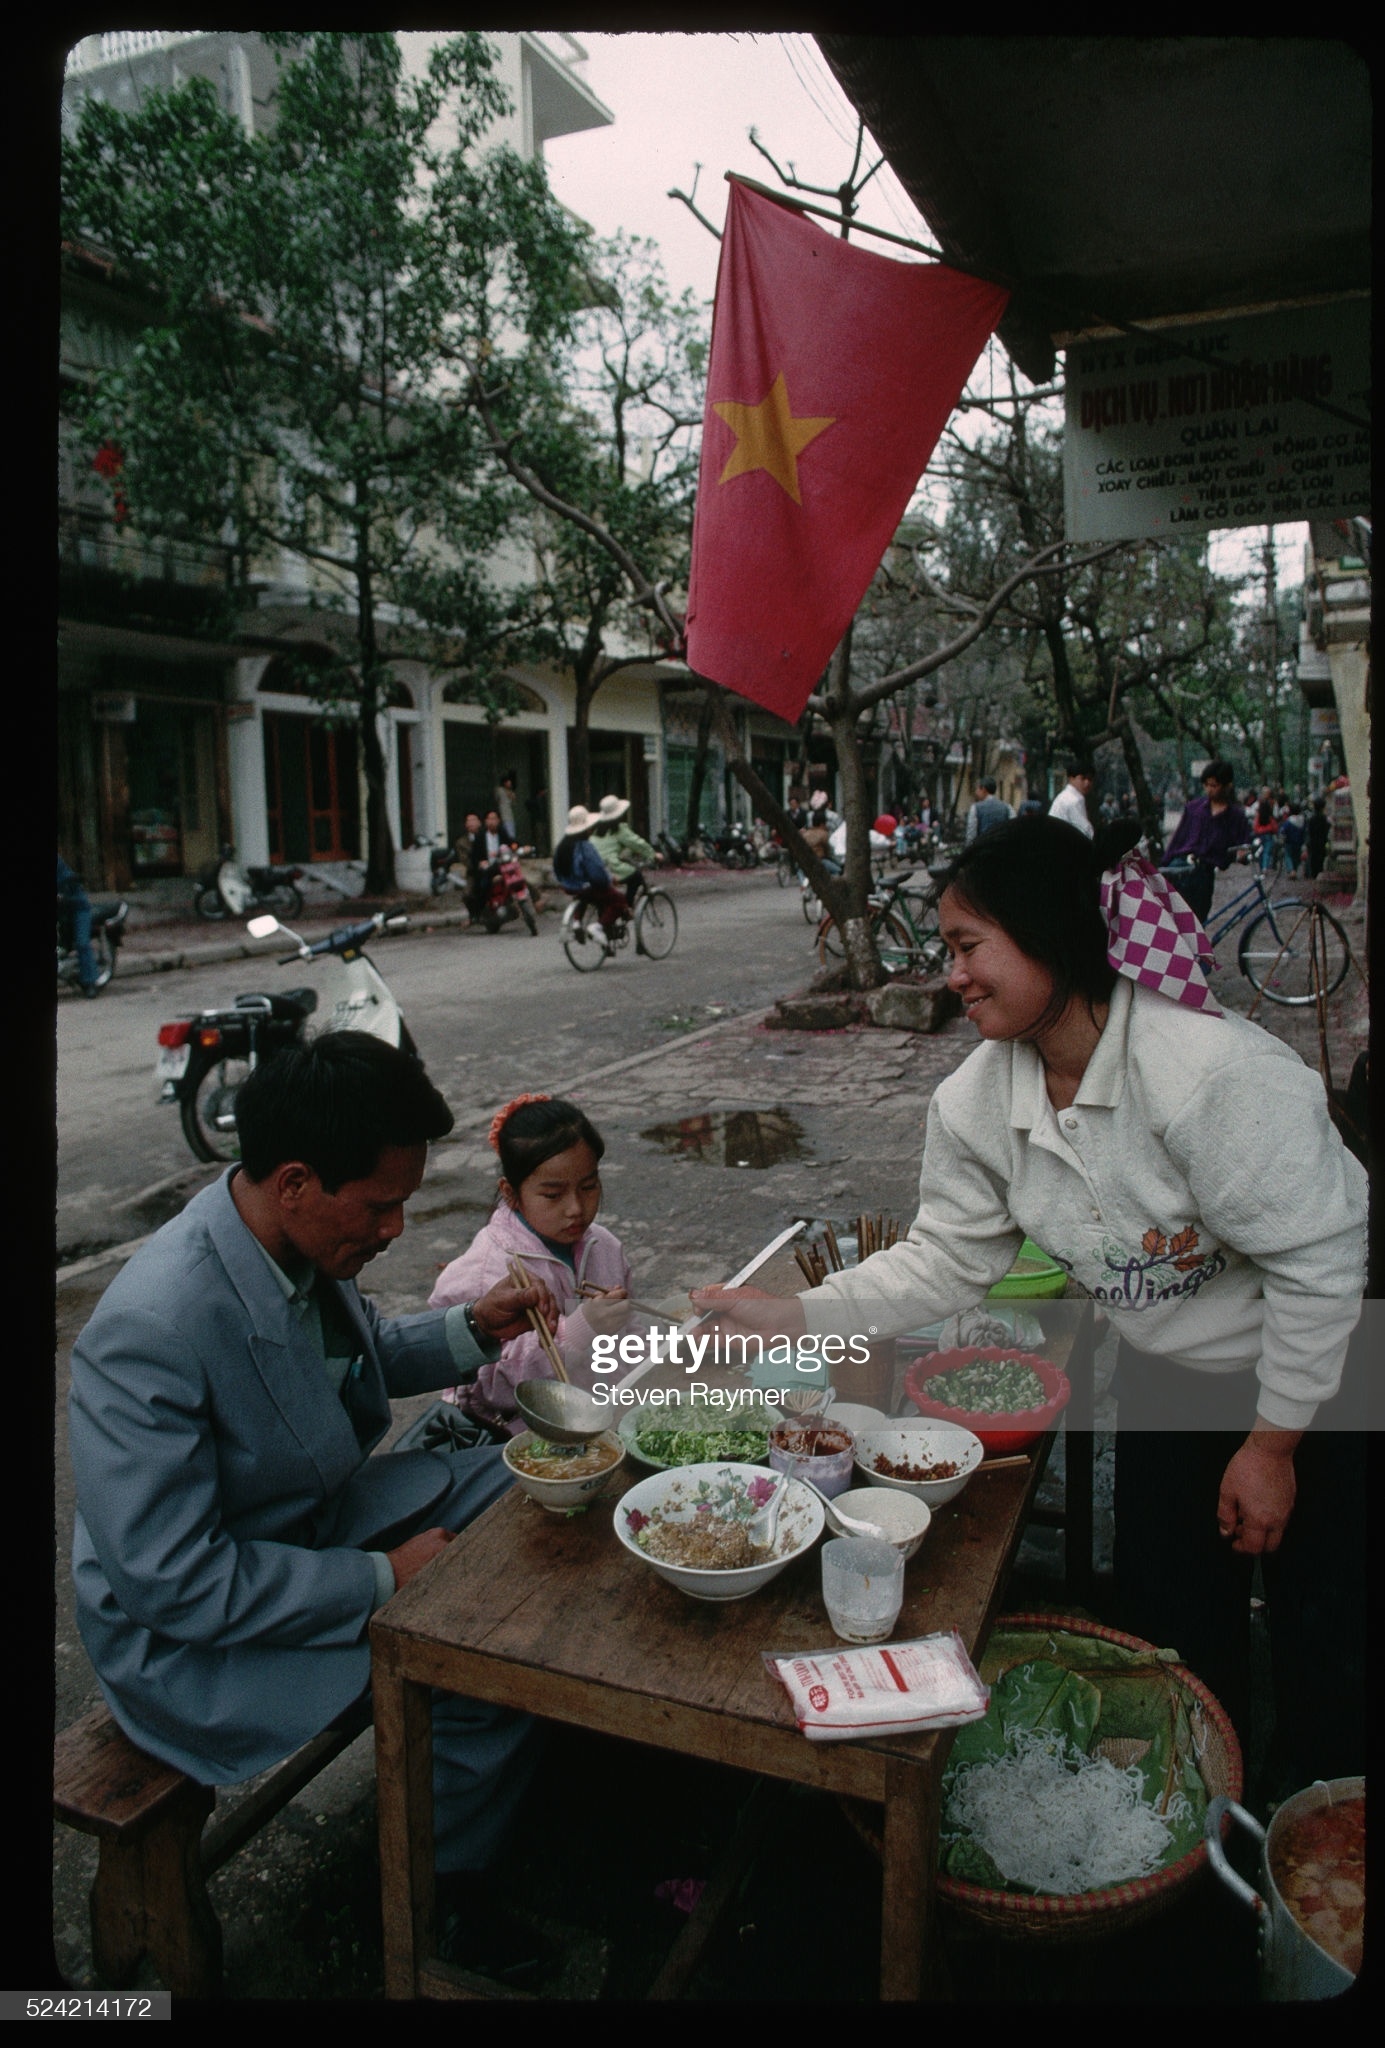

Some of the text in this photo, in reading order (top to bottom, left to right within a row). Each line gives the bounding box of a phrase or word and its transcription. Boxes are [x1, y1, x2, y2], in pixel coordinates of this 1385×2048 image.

[1081, 384, 1127, 434] DỊCH
[1272, 352, 1332, 402] HÀNG
[1095, 458, 1125, 475] CÁC
[1098, 479, 1132, 494] XOAY
[1266, 477, 1297, 494] CÁC
[1170, 506, 1199, 523] LÀM
[1306, 492, 1336, 509] CÁC
